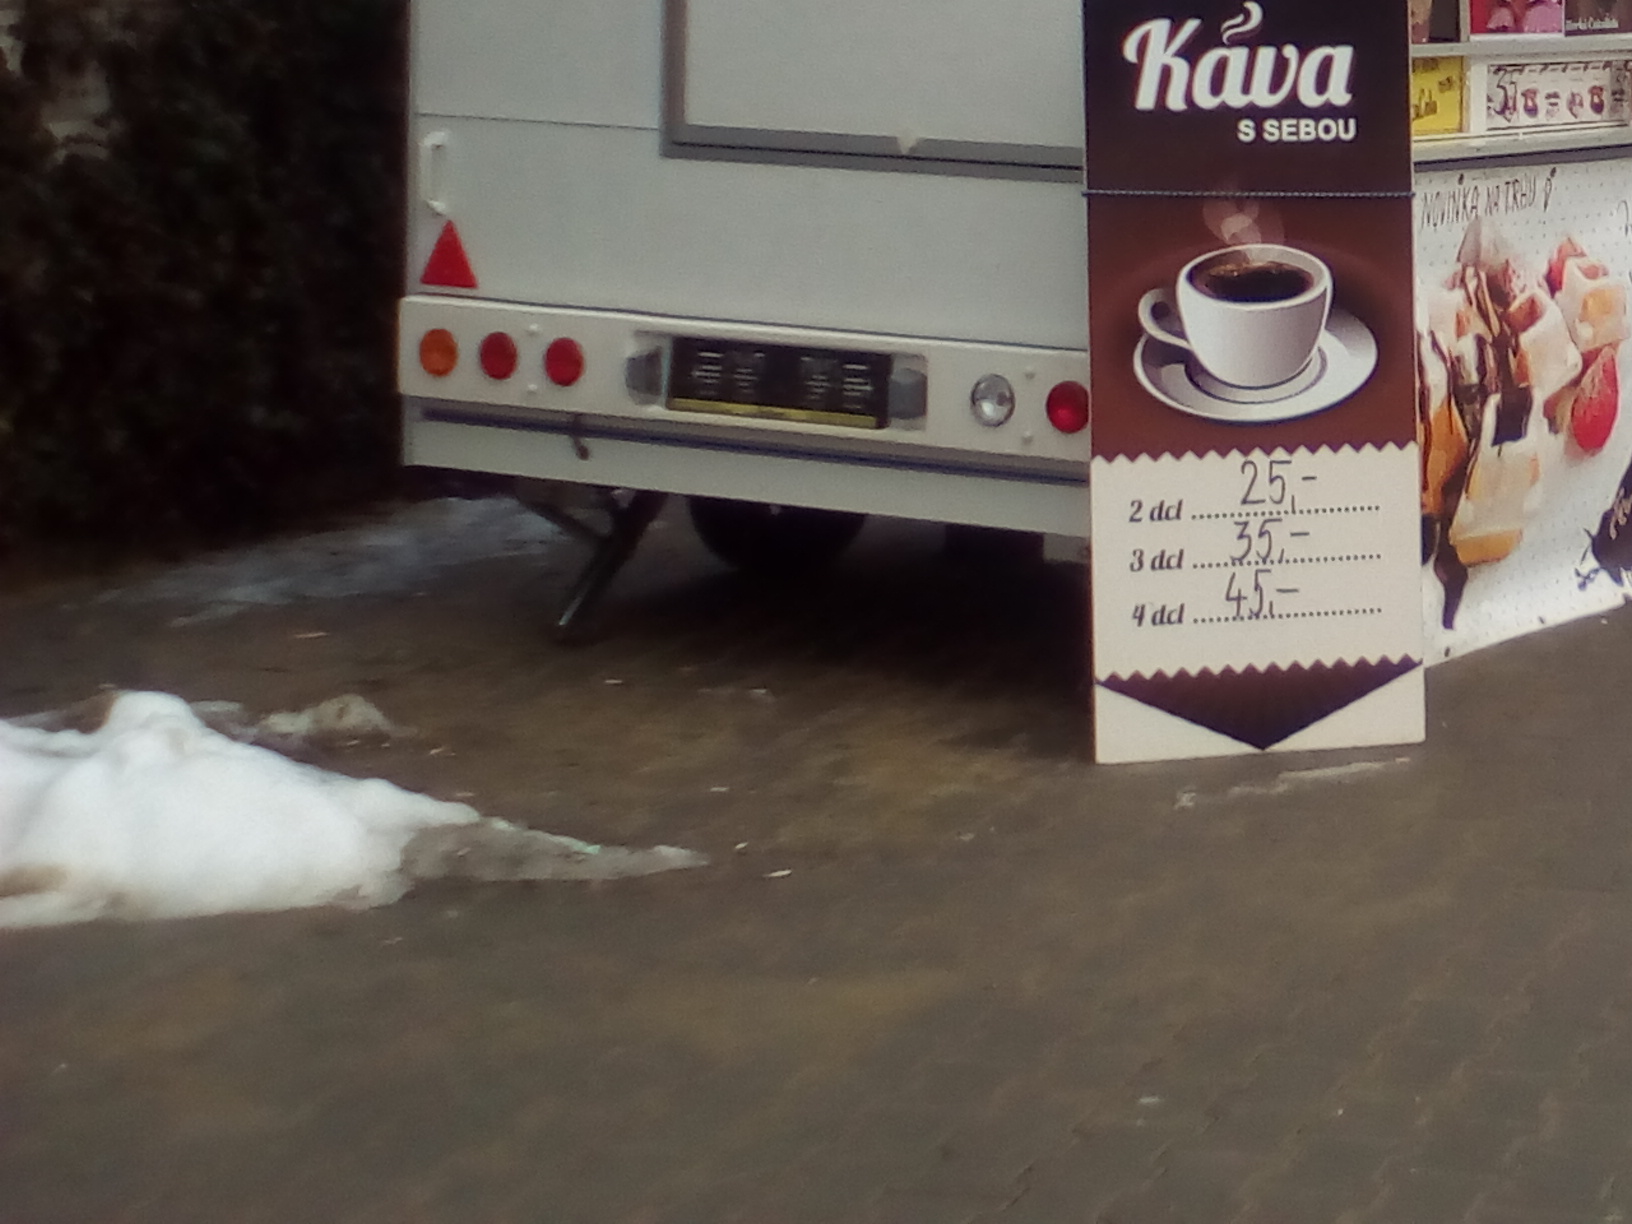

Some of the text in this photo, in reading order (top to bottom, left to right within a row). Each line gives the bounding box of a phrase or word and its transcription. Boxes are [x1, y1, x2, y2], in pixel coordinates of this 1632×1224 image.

[1236, 118, 1357, 143] S SEBOU
[1128, 499, 1144, 523] 2
[1129, 549, 1145, 572] 3
[1131, 603, 1147, 627] 4
